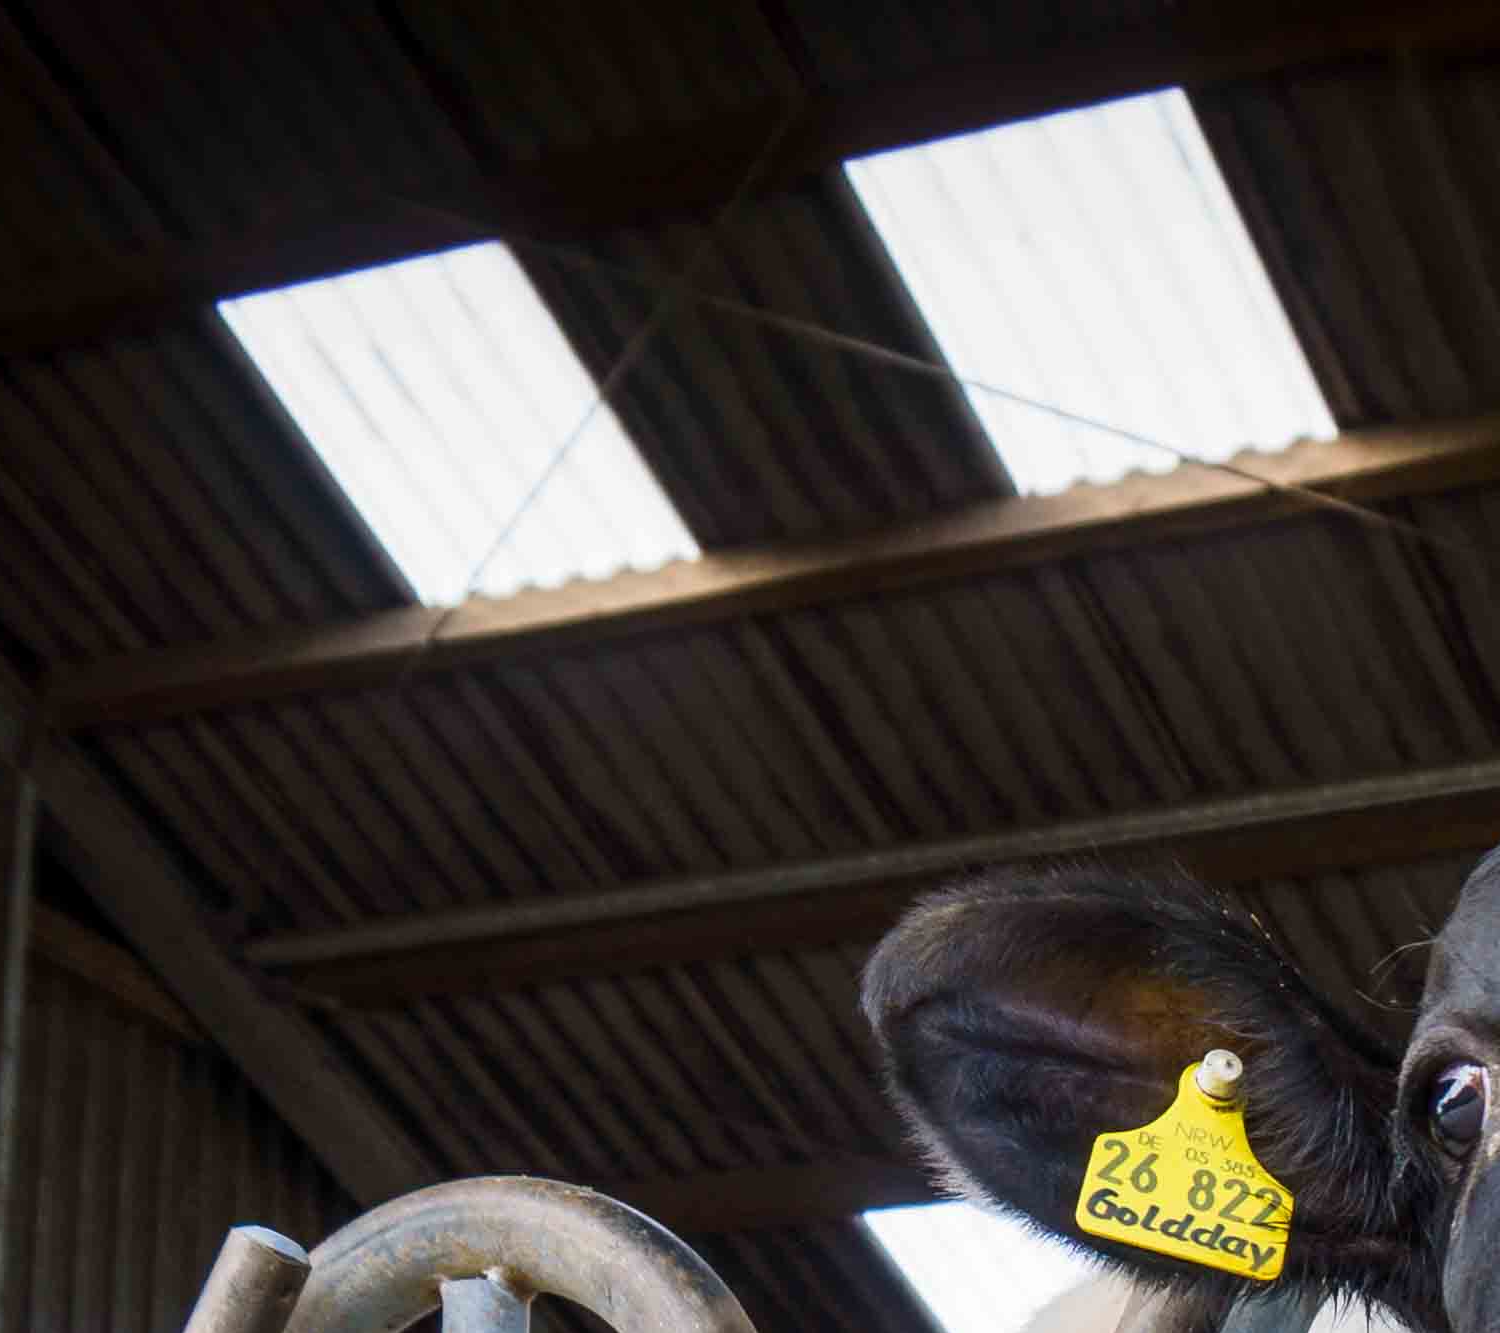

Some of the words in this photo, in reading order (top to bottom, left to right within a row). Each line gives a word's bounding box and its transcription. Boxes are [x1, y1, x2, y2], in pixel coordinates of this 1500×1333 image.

[1138, 1131, 1162, 1150] DE
[1185, 1147, 1209, 1165] 05
[1175, 1121, 1235, 1151] NRW
[1096, 1138, 1159, 1194] 26
[1187, 1168, 1288, 1228] 822
[1086, 1187, 1277, 1271] Goldday
